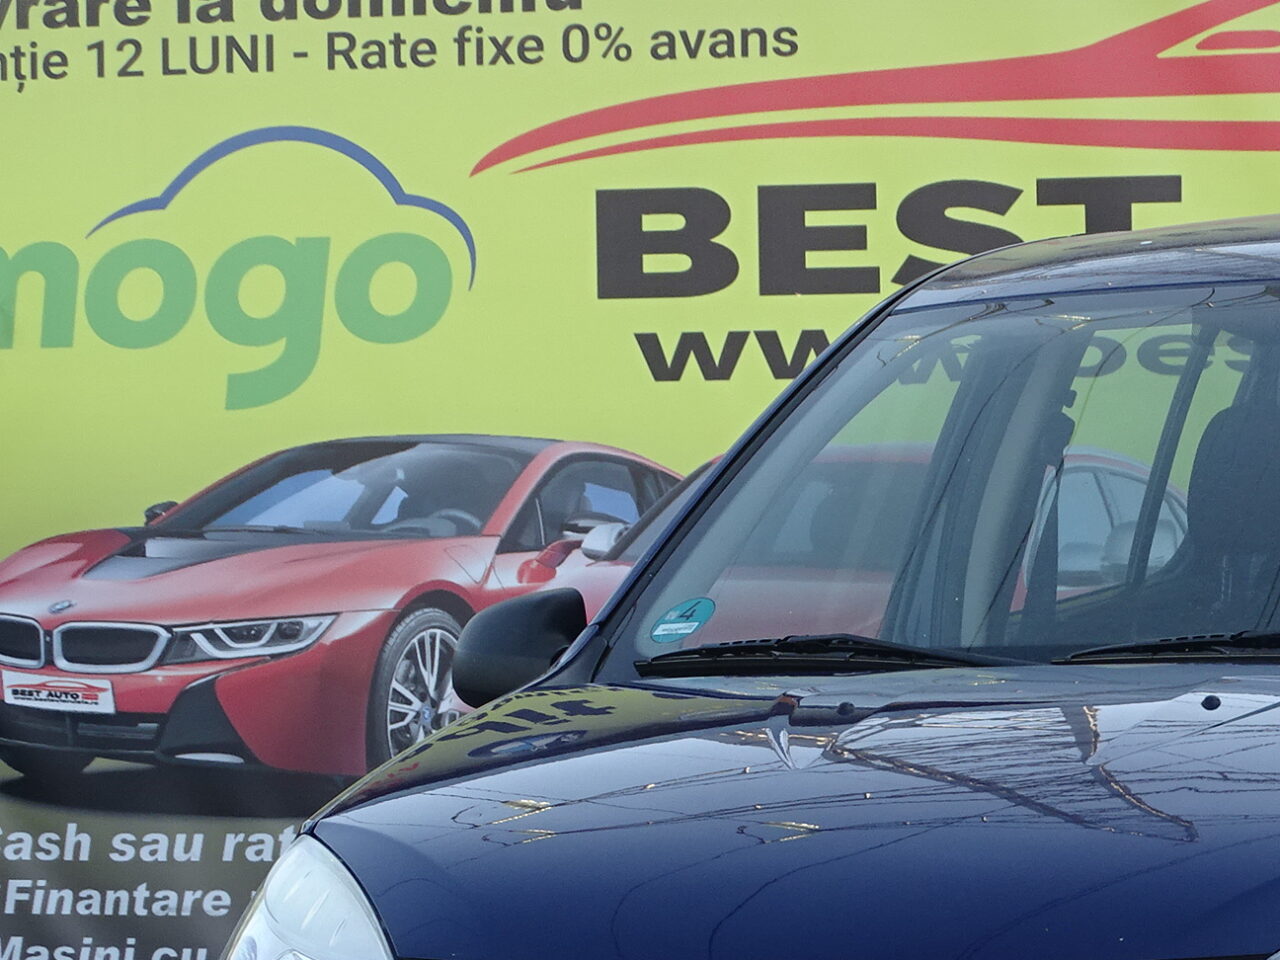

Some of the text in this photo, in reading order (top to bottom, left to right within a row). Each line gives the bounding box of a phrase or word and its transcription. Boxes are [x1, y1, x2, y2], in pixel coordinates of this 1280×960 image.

[0, 40, 69, 93] ție
[87, 38, 144, 78] 12
[162, 34, 274, 76] LUNI
[326, 30, 437, 71] Rate
[454, 25, 545, 66] fixe
[562, 22, 632, 64] 0%
[650, 25, 799, 61] avans
[595, 175, 1182, 300] BEST
[679, 600, 702, 620] 4
[12, 688, 42, 697] BEST
[47, 690, 80, 700] AUTO
[0, 822, 297, 862] ash sau rat
[4, 879, 232, 917] Finantare
